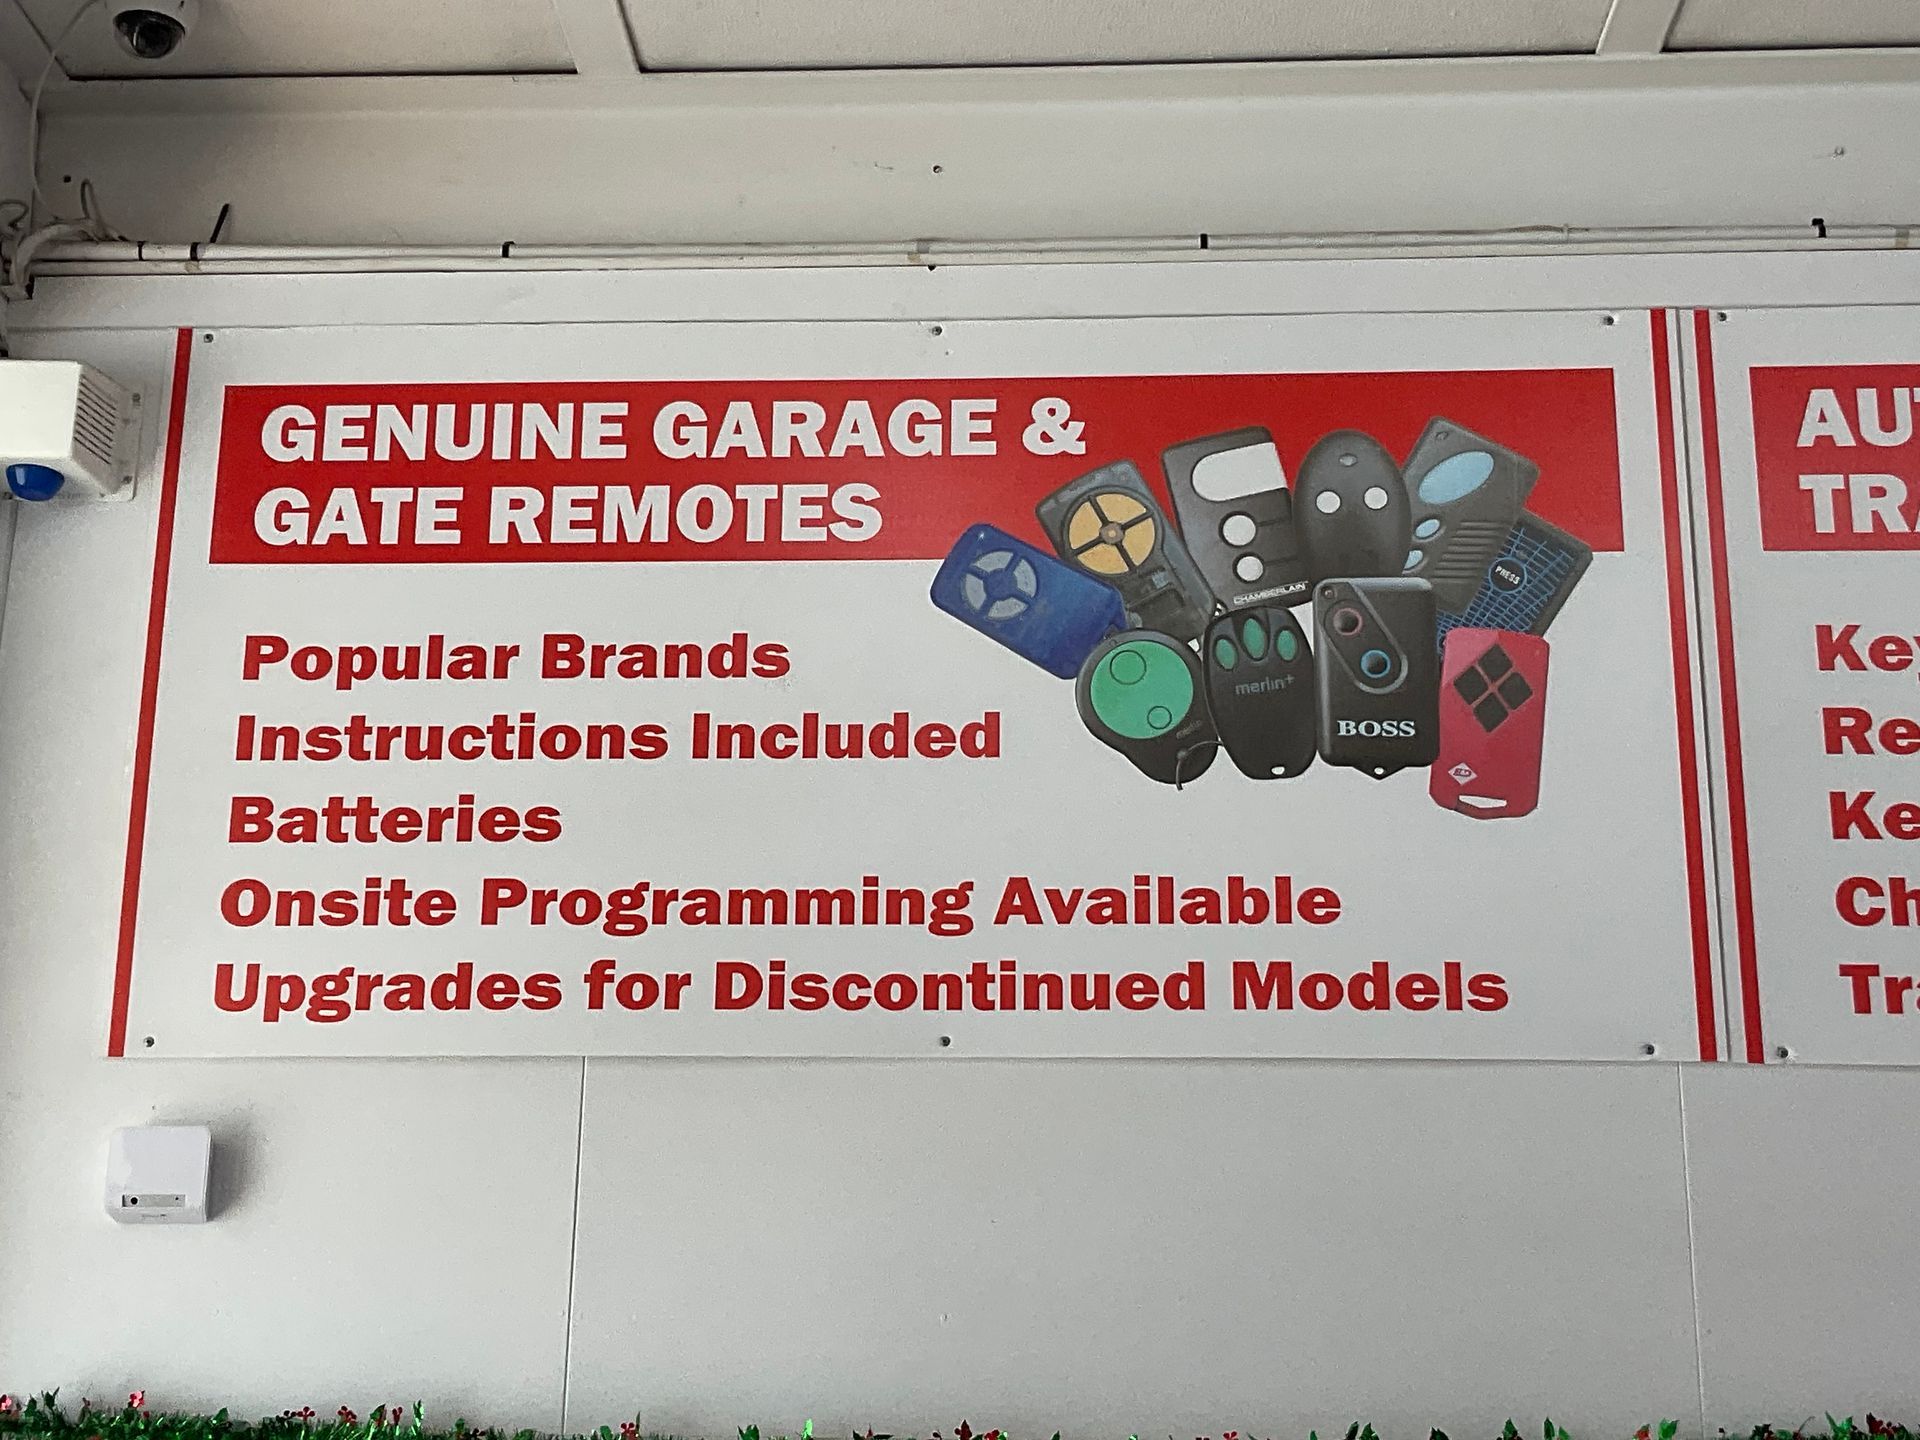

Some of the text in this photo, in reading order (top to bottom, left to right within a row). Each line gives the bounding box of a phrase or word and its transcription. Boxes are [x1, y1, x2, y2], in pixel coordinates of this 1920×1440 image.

[261, 397, 1086, 463] GENUINE GARAGE &
[254, 482, 883, 546] GATE REMOTES
[1798, 473, 1920, 534] TR
[1495, 565, 1520, 585] PRESS
[242, 632, 790, 690] Popular Brands
[235, 711, 1001, 761] Instructions Included
[1337, 720, 1416, 737] BOSS
[228, 793, 561, 843] Batteries
[220, 874, 1341, 937] Onsite Programming Available
[213, 959, 1509, 1023] Upgrades for Discontinued Models
[1839, 963, 1920, 1014] Tr
